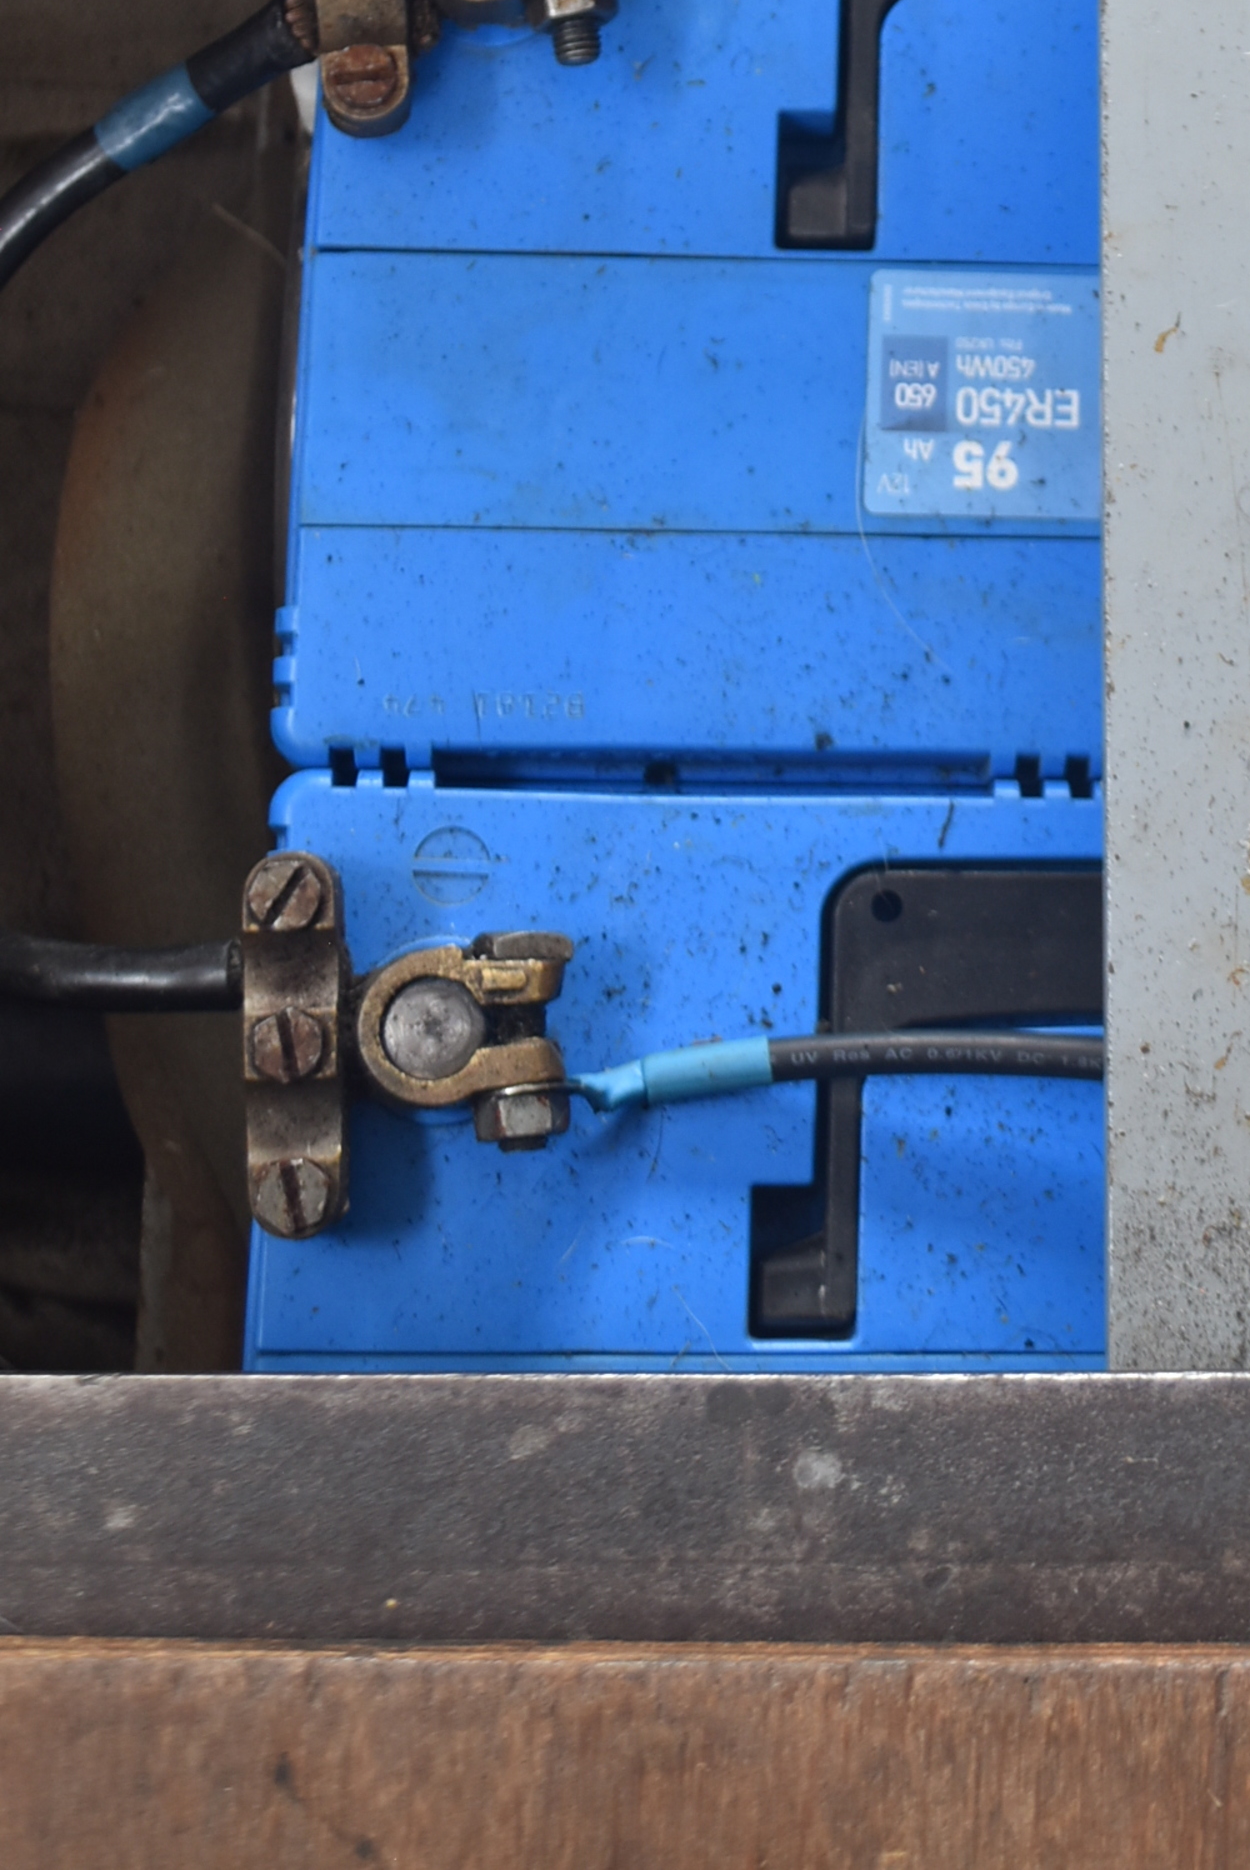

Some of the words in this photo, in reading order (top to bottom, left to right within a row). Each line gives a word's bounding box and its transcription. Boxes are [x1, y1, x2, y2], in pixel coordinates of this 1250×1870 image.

[956, 354, 1036, 378] 450Wh
[894, 382, 937, 409] 650
[956, 387, 1080, 428] ER450
[903, 438, 934, 461] Ah
[953, 439, 1019, 491] 95
[876, 472, 910, 495] 12V
